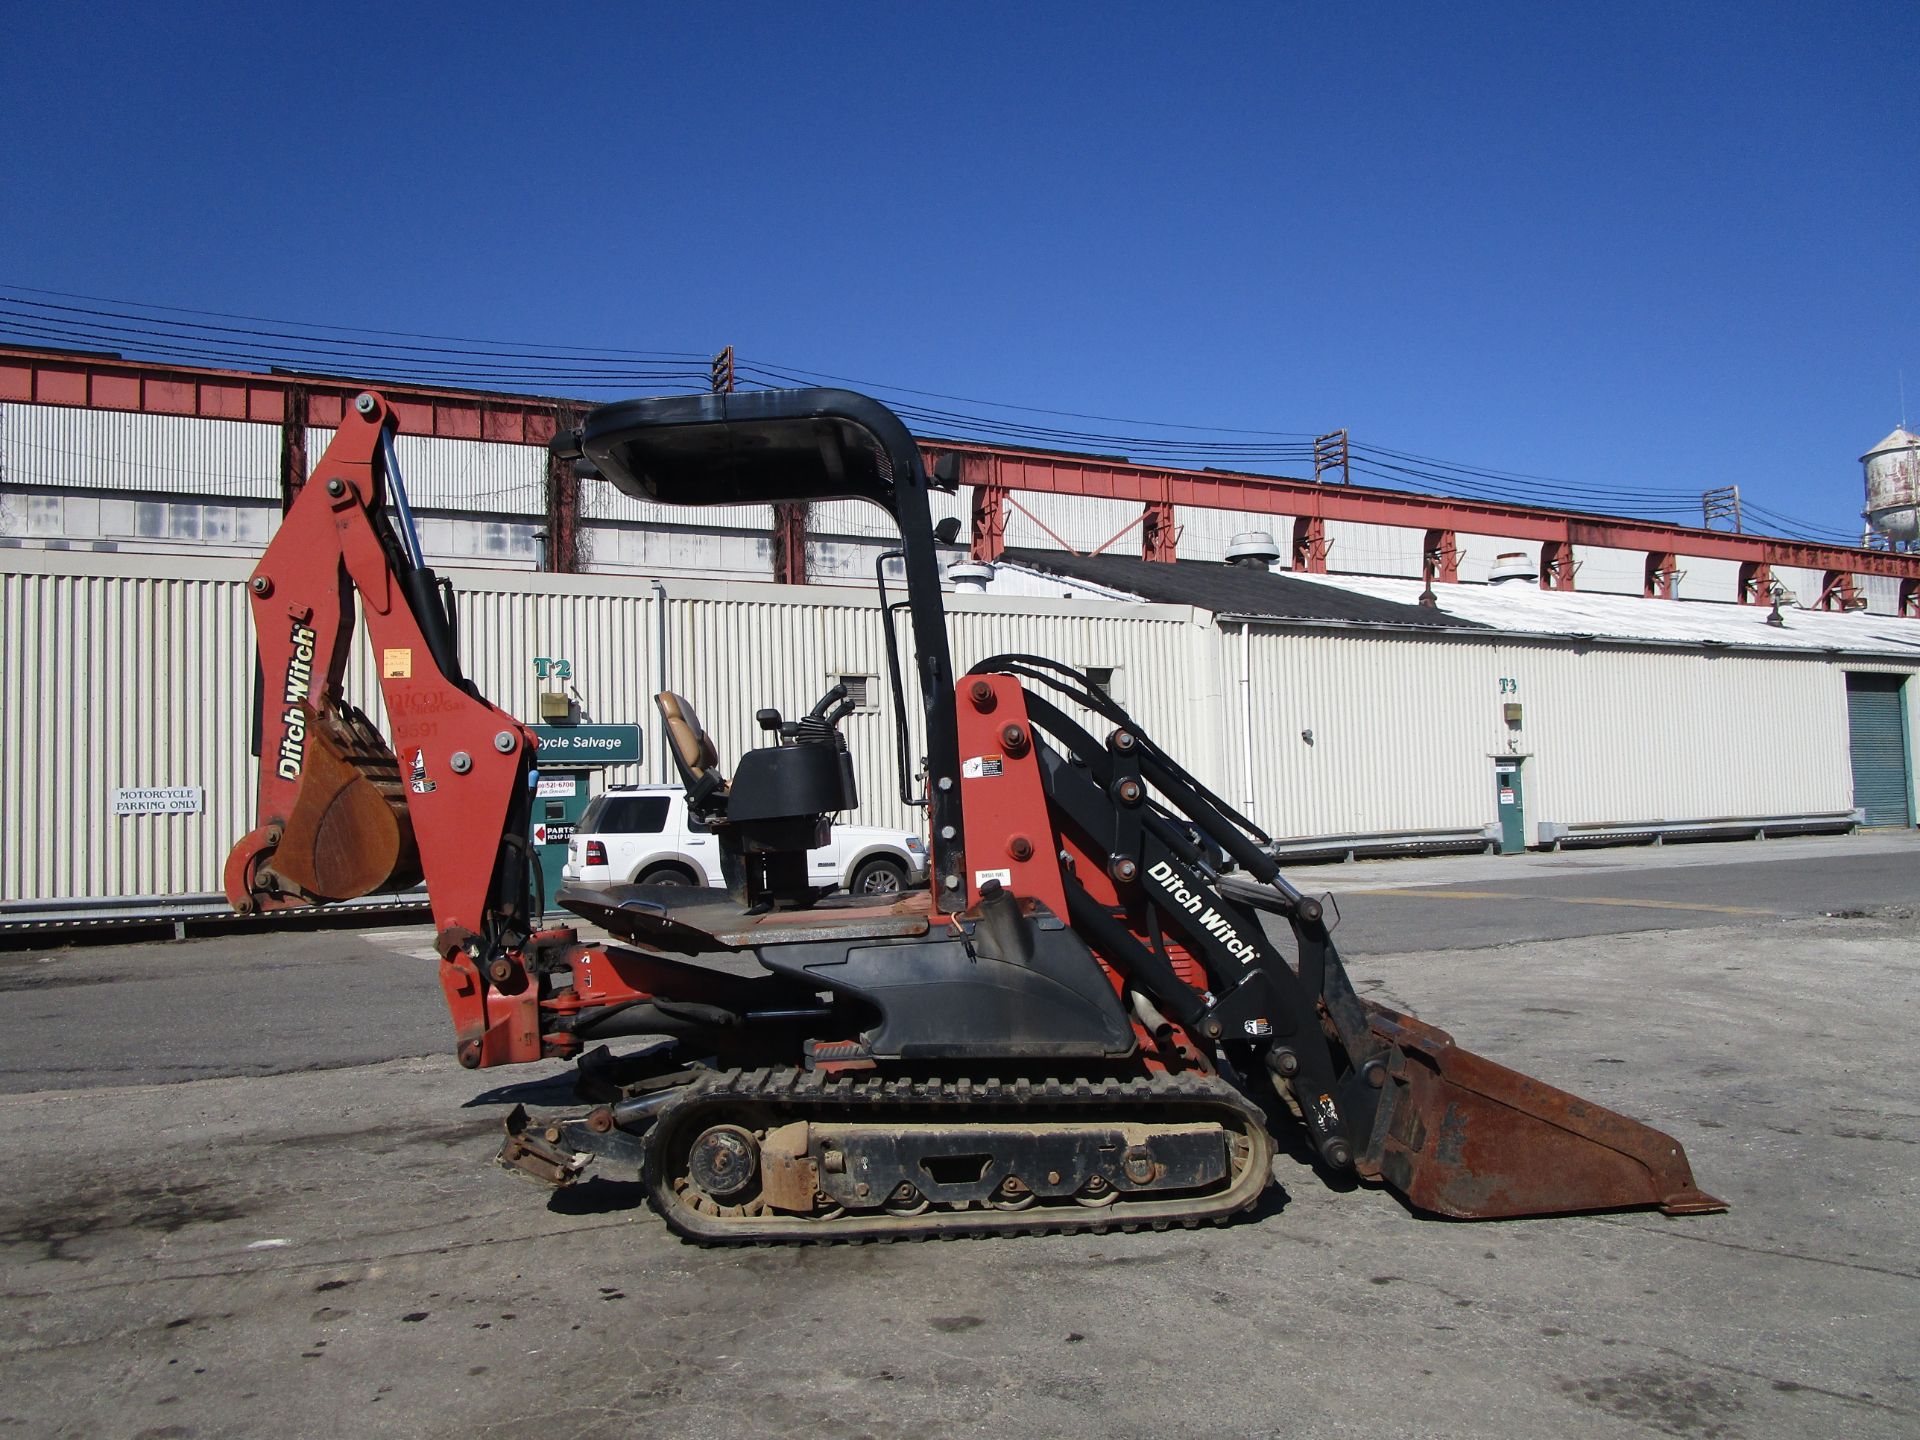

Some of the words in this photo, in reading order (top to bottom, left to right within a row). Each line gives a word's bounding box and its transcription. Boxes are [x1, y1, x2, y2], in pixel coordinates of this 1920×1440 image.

[287, 625, 315, 704] Witch
[533, 657, 572, 679] T2
[1499, 677, 1517, 694] T3
[279, 707, 305, 781] Ditch
[573, 736, 621, 749] Salvage
[120, 790, 194, 799] MOTORCYCLE
[116, 801, 166, 810] PARKING
[170, 800, 197, 809] ONLY
[1147, 860, 1202, 914] Ditch
[1198, 906, 1256, 965] Witch
